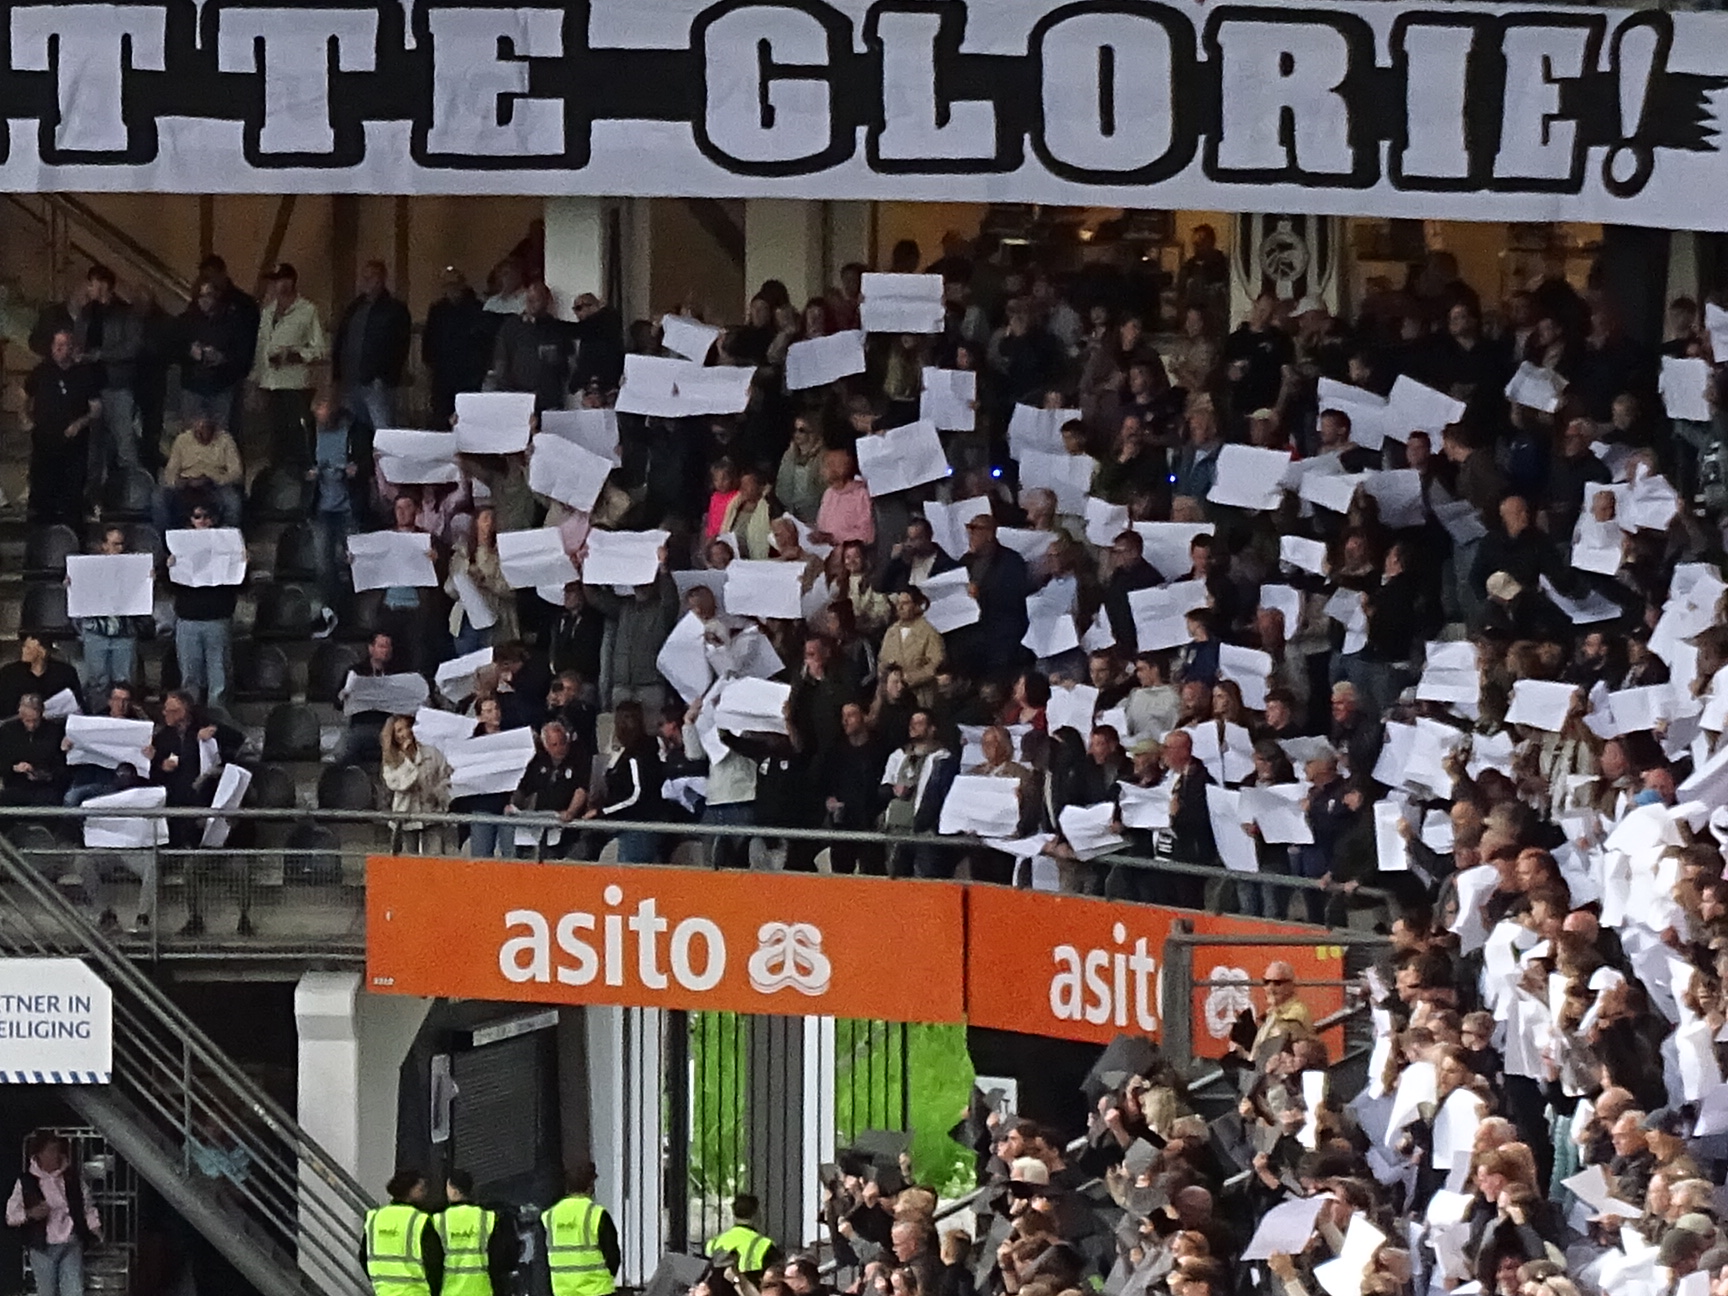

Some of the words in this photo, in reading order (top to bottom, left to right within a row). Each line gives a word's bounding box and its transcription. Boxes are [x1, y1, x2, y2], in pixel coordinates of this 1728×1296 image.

[497, 884, 727, 992] asito
[1049, 923, 1164, 1033] asit
[69, 995, 91, 1013] IN
